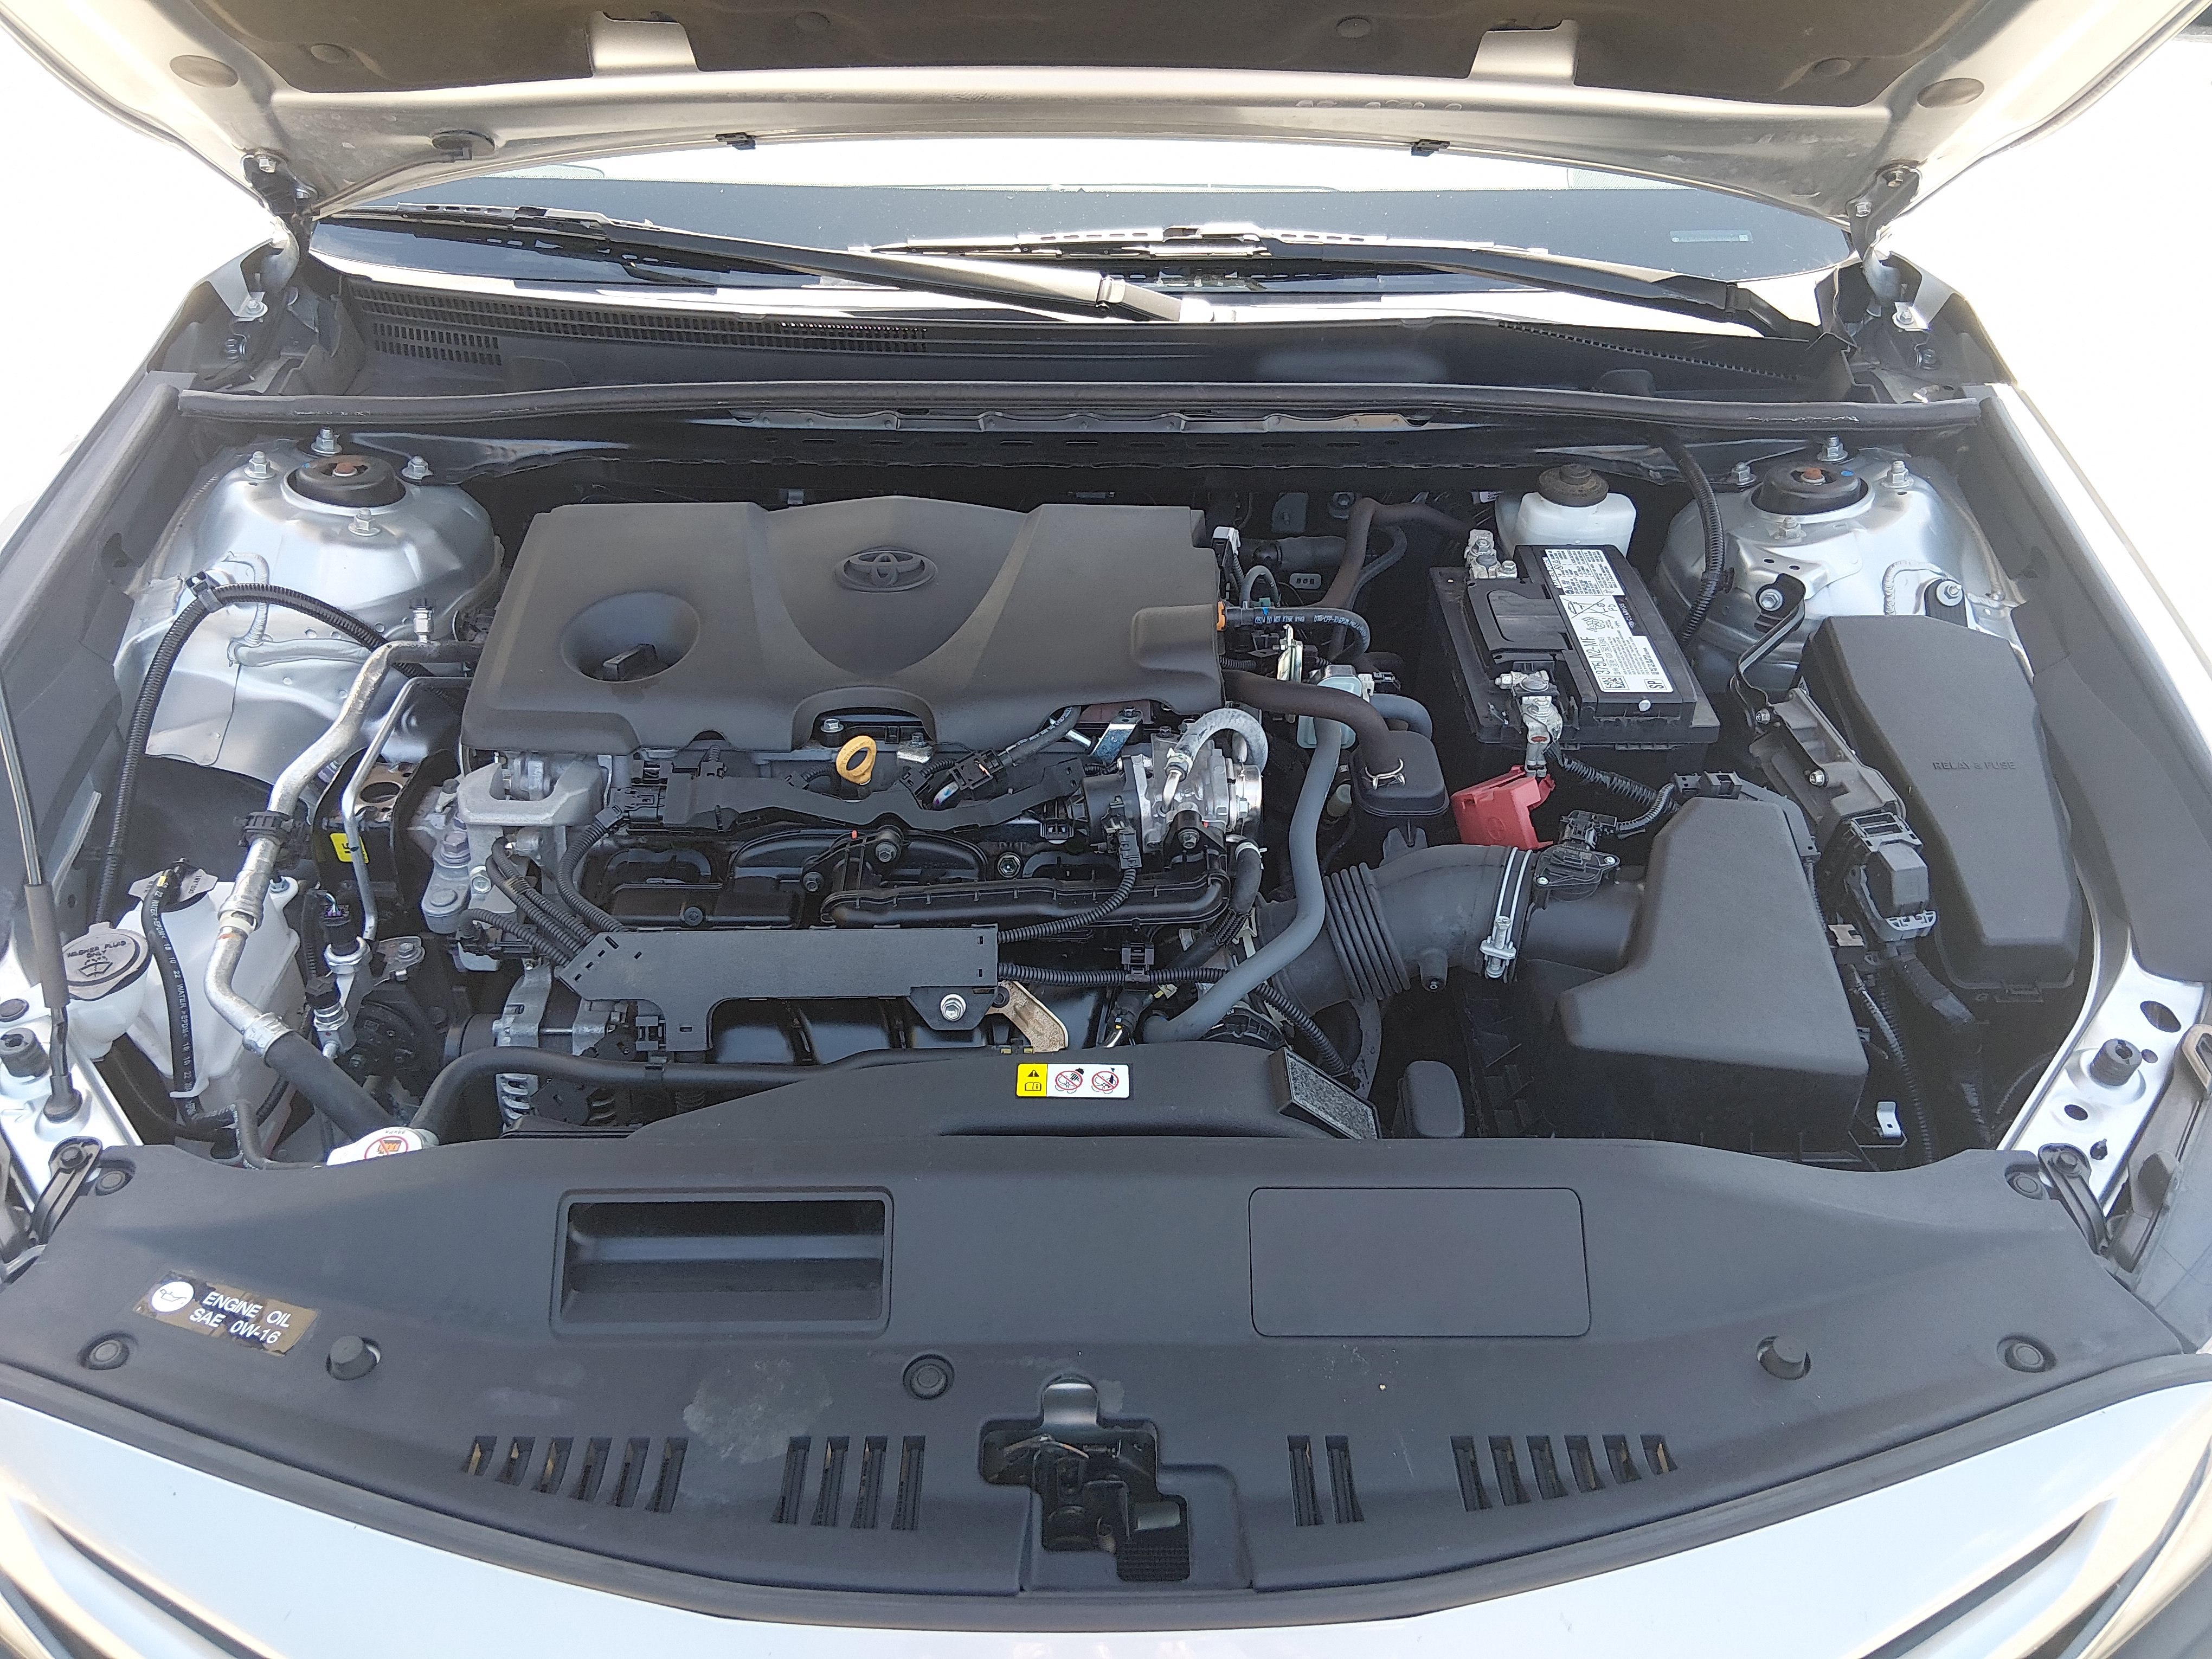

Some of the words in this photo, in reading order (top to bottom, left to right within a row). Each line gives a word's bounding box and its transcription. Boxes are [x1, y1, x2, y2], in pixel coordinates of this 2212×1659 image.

[1619, 603, 1632, 621] CLARIOS
[1580, 636, 1610, 674] 375LN2-MF
[1649, 680, 1664, 689] SP
[1933, 761, 1970, 770] RELAY
[1974, 762, 1983, 770] &
[1985, 760, 2016, 770] FUSE
[87, 949, 107, 958] ONLY
[173, 970, 181, 979] 22
[176, 983, 187, 1008] WATER
[202, 1291, 263, 1319] ENGINE
[266, 1310, 292, 1328] OIL
[190, 1308, 227, 1327] SAE
[230, 1320, 281, 1344] 0W-16
